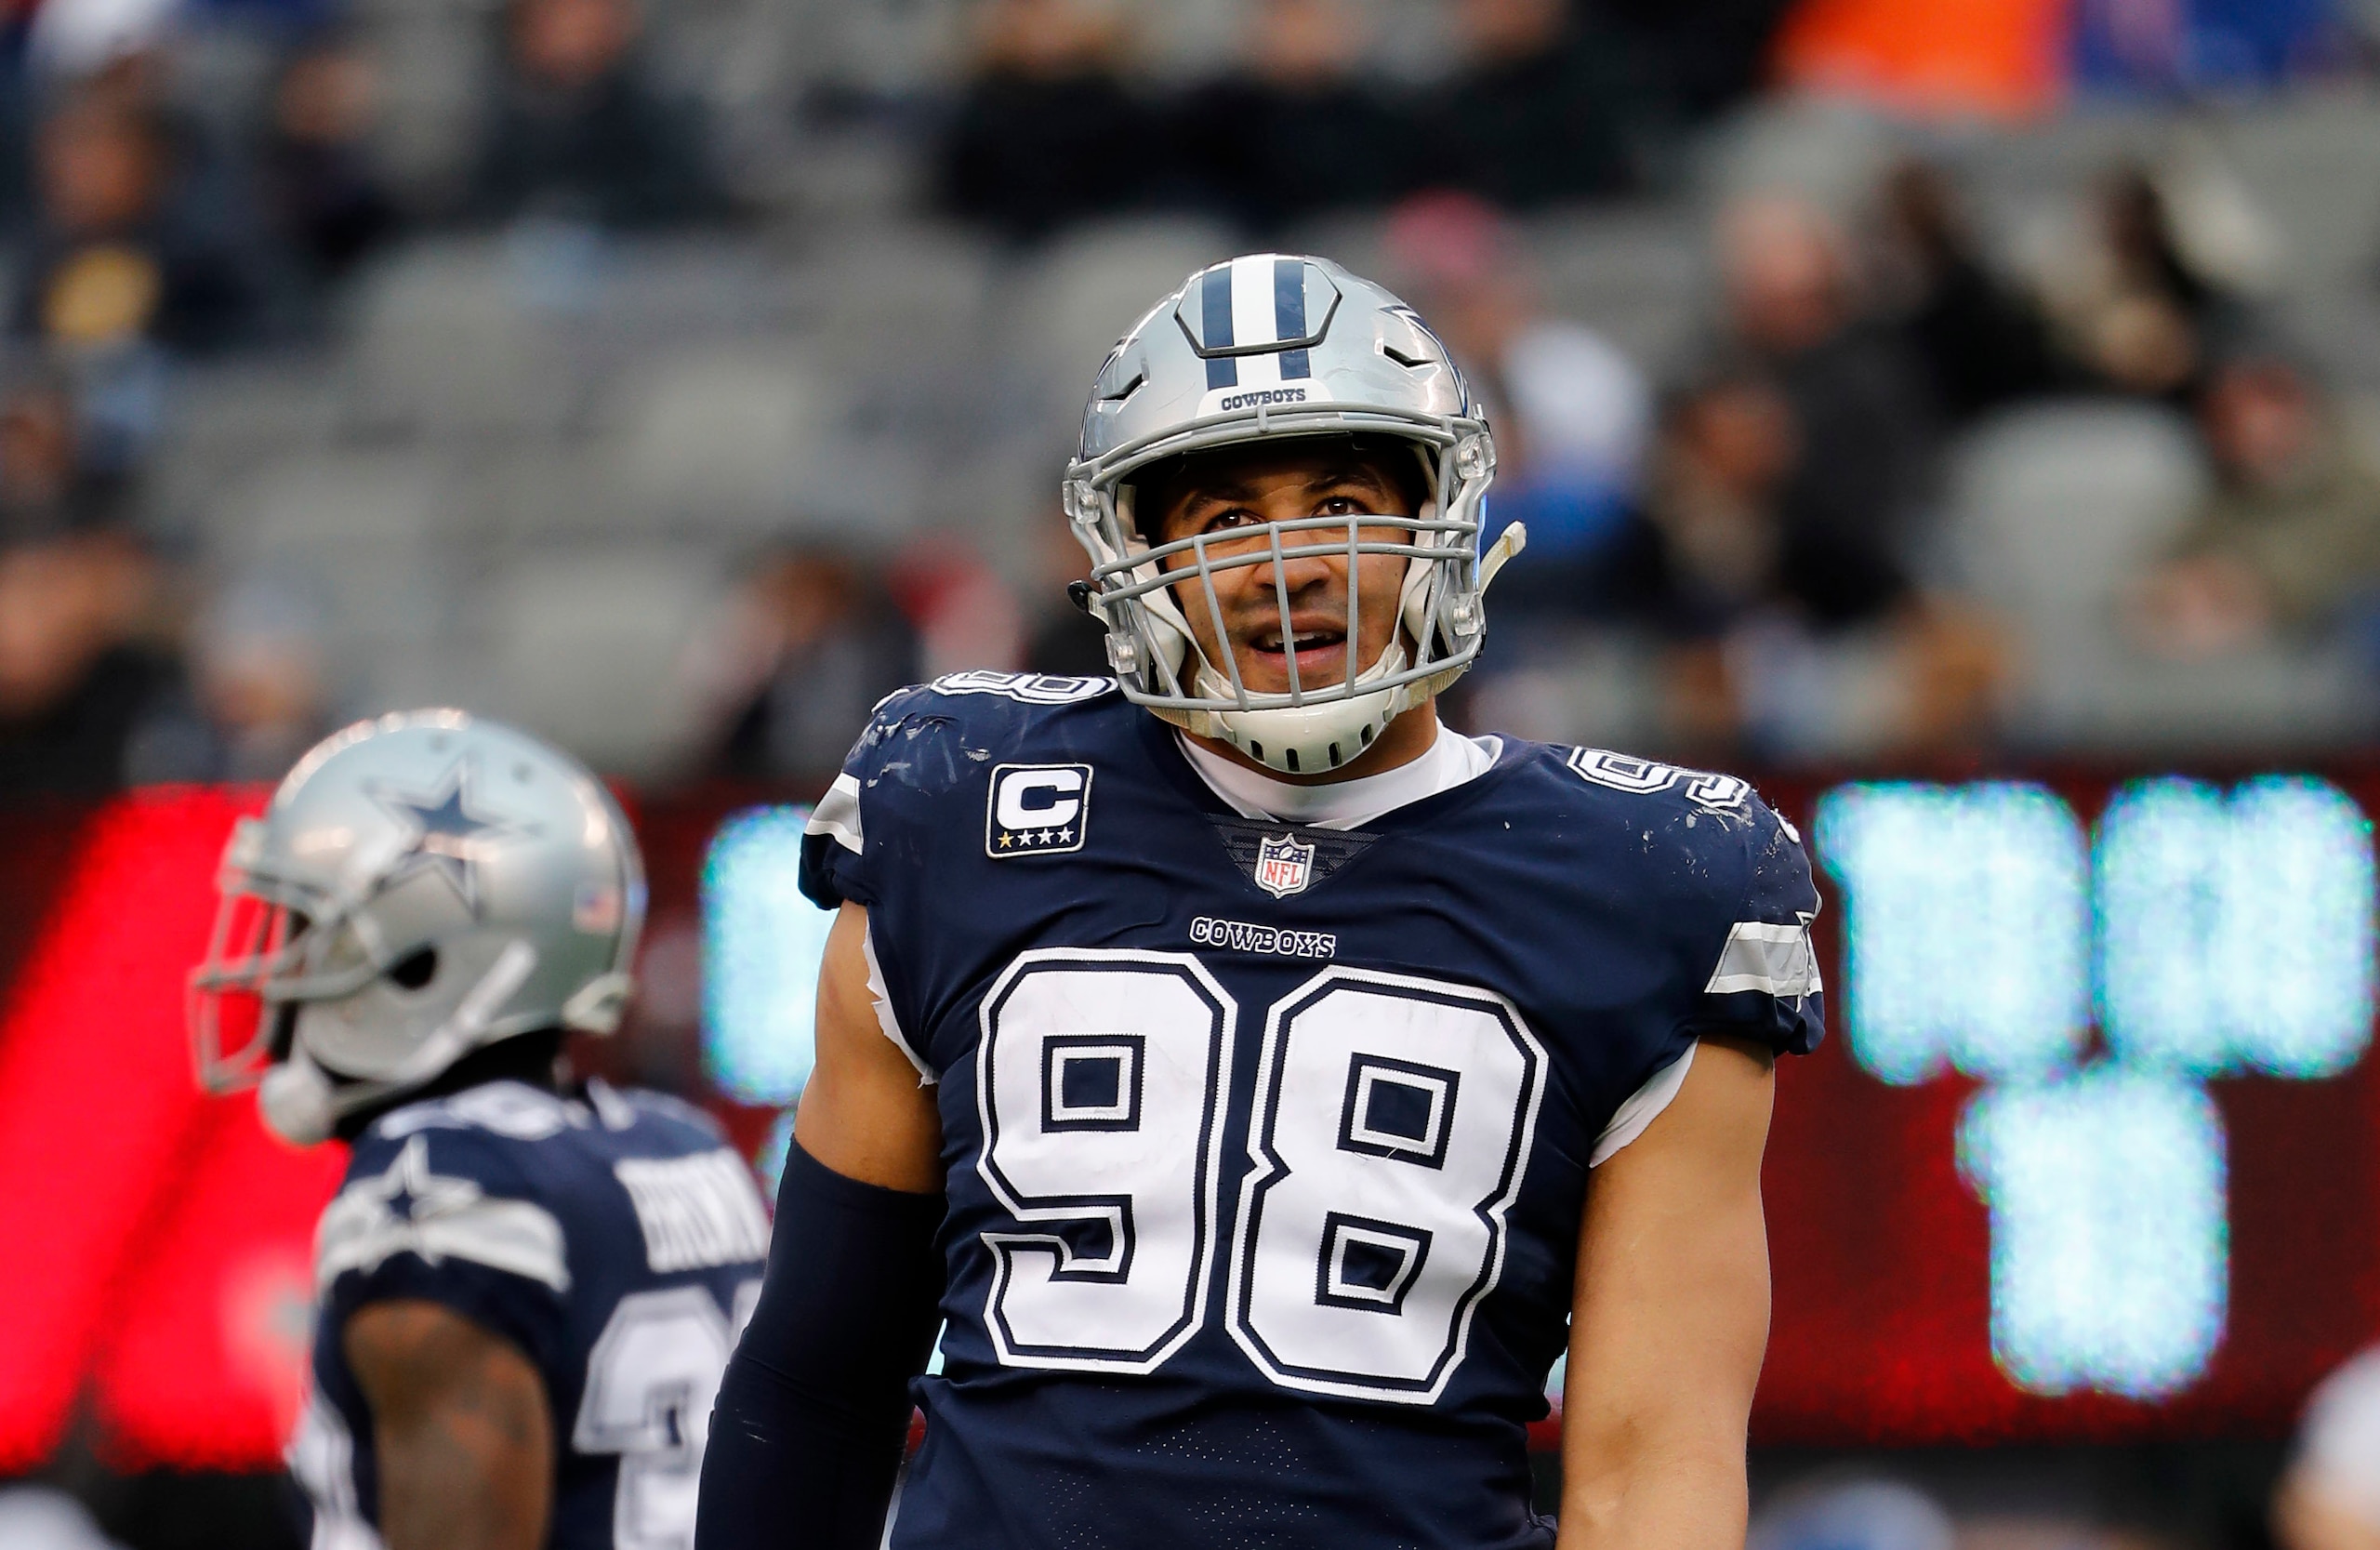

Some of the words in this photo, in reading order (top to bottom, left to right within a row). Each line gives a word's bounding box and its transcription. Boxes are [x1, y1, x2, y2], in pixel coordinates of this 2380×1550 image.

[1221, 388, 1307, 411] COWBOYS
[997, 769, 1083, 830] C
[1263, 860, 1301, 887] NFL
[1189, 916, 1337, 959] COWBOYS
[976, 947, 1550, 1406] 98
